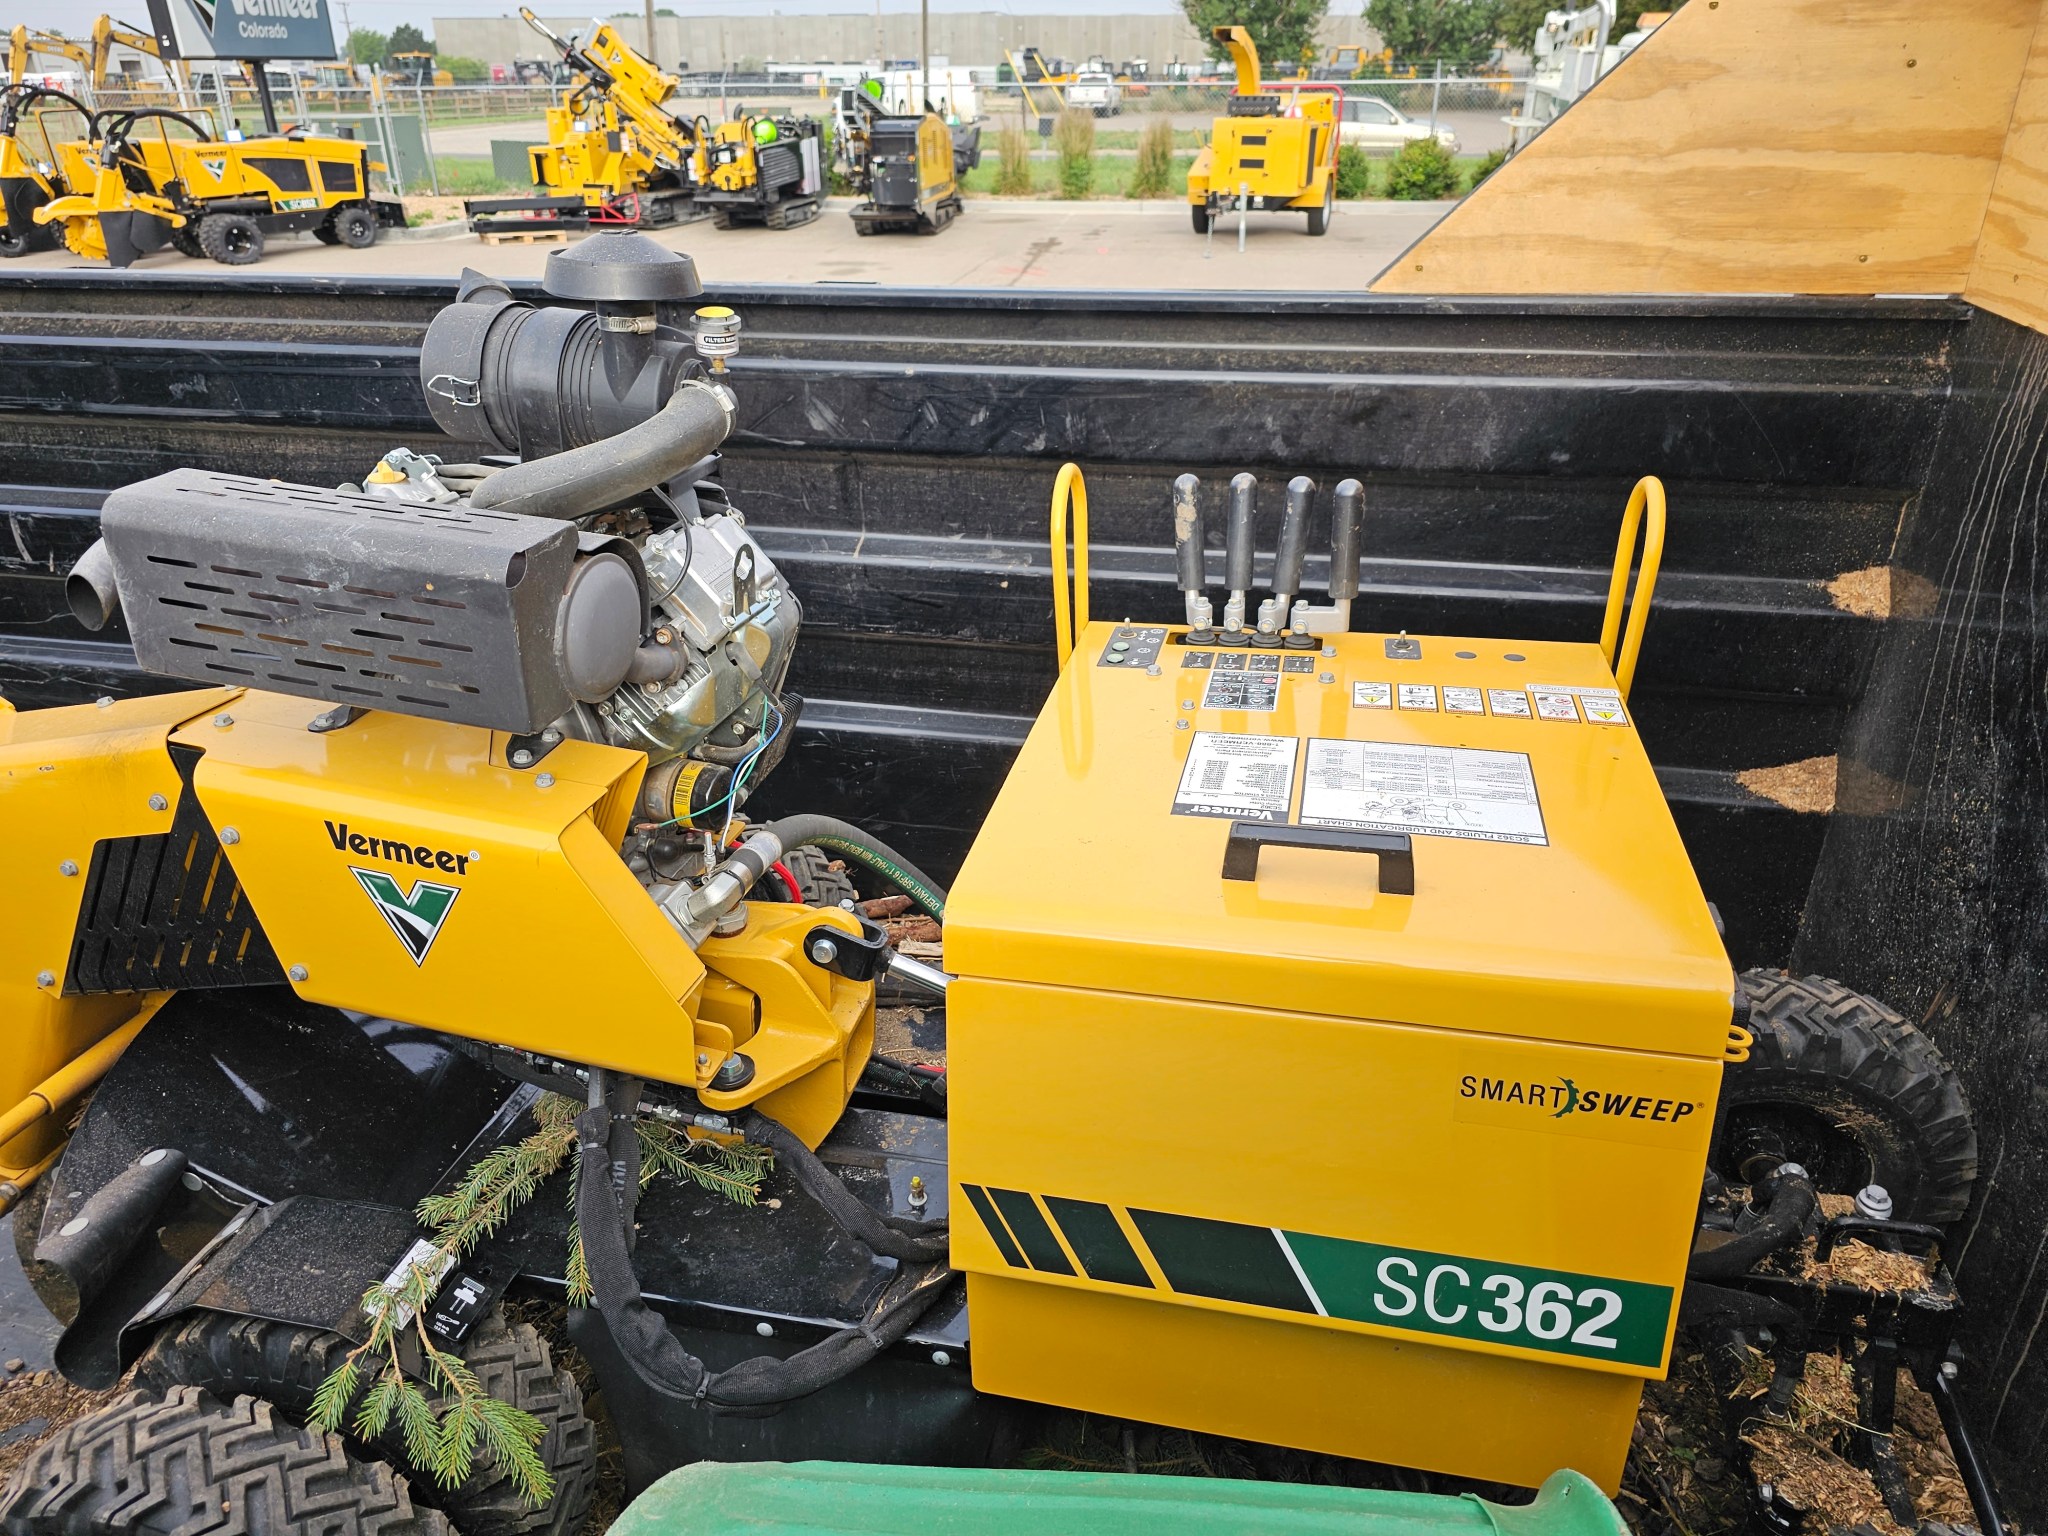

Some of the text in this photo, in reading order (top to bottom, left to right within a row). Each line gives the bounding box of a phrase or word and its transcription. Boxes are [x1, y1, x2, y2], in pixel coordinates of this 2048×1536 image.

[232, 0, 318, 19] Vermeer
[238, 20, 288, 39] Colorado
[195, 150, 228, 158] Vermeer
[1190, 804, 1274, 820] Vermeer
[1355, 822, 1427, 833] LUBRICATION
[1455, 830, 1494, 838] FLUIDS
[1496, 834, 1530, 842] SC362
[324, 820, 468, 876] Vermeer
[870, 857, 889, 872] HALF
[894, 872, 914, 889] SRF16
[912, 885, 940, 912] DEFIANT
[1460, 1076, 1694, 1124] SMART SWEEP
[1372, 1256, 1624, 1350] SC362
